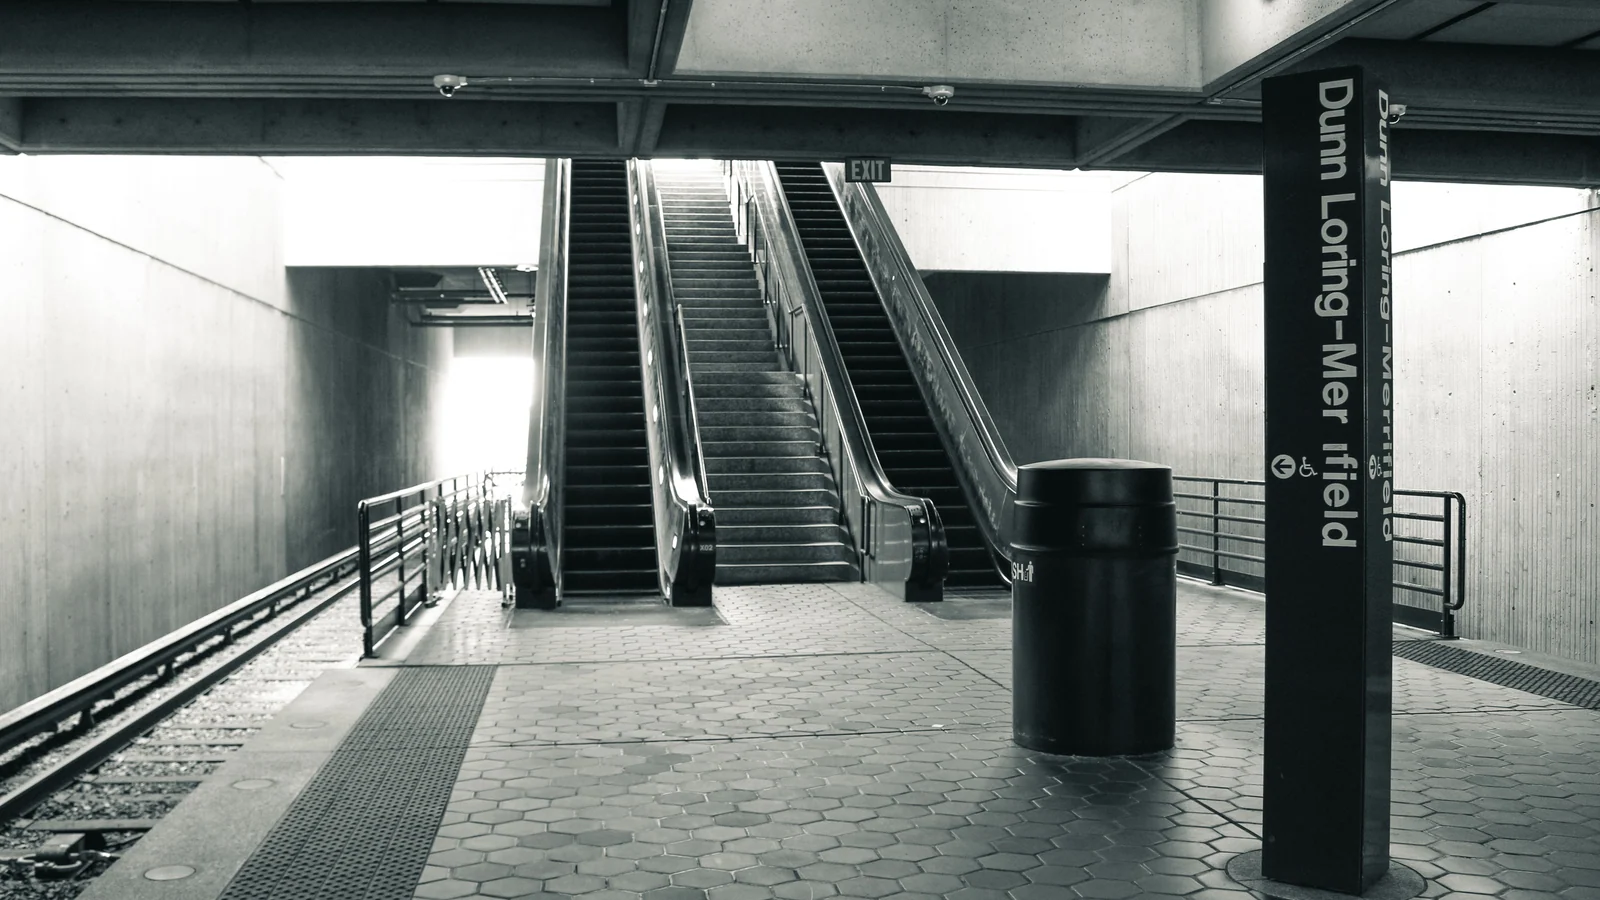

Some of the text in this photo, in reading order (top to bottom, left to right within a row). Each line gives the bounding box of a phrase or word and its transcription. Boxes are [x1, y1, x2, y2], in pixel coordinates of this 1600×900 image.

[851, 160, 885, 180] EXIT
[1319, 78, 1354, 180] Dunn
[1379, 89, 1392, 541] Dunn Loring-Merrifield
